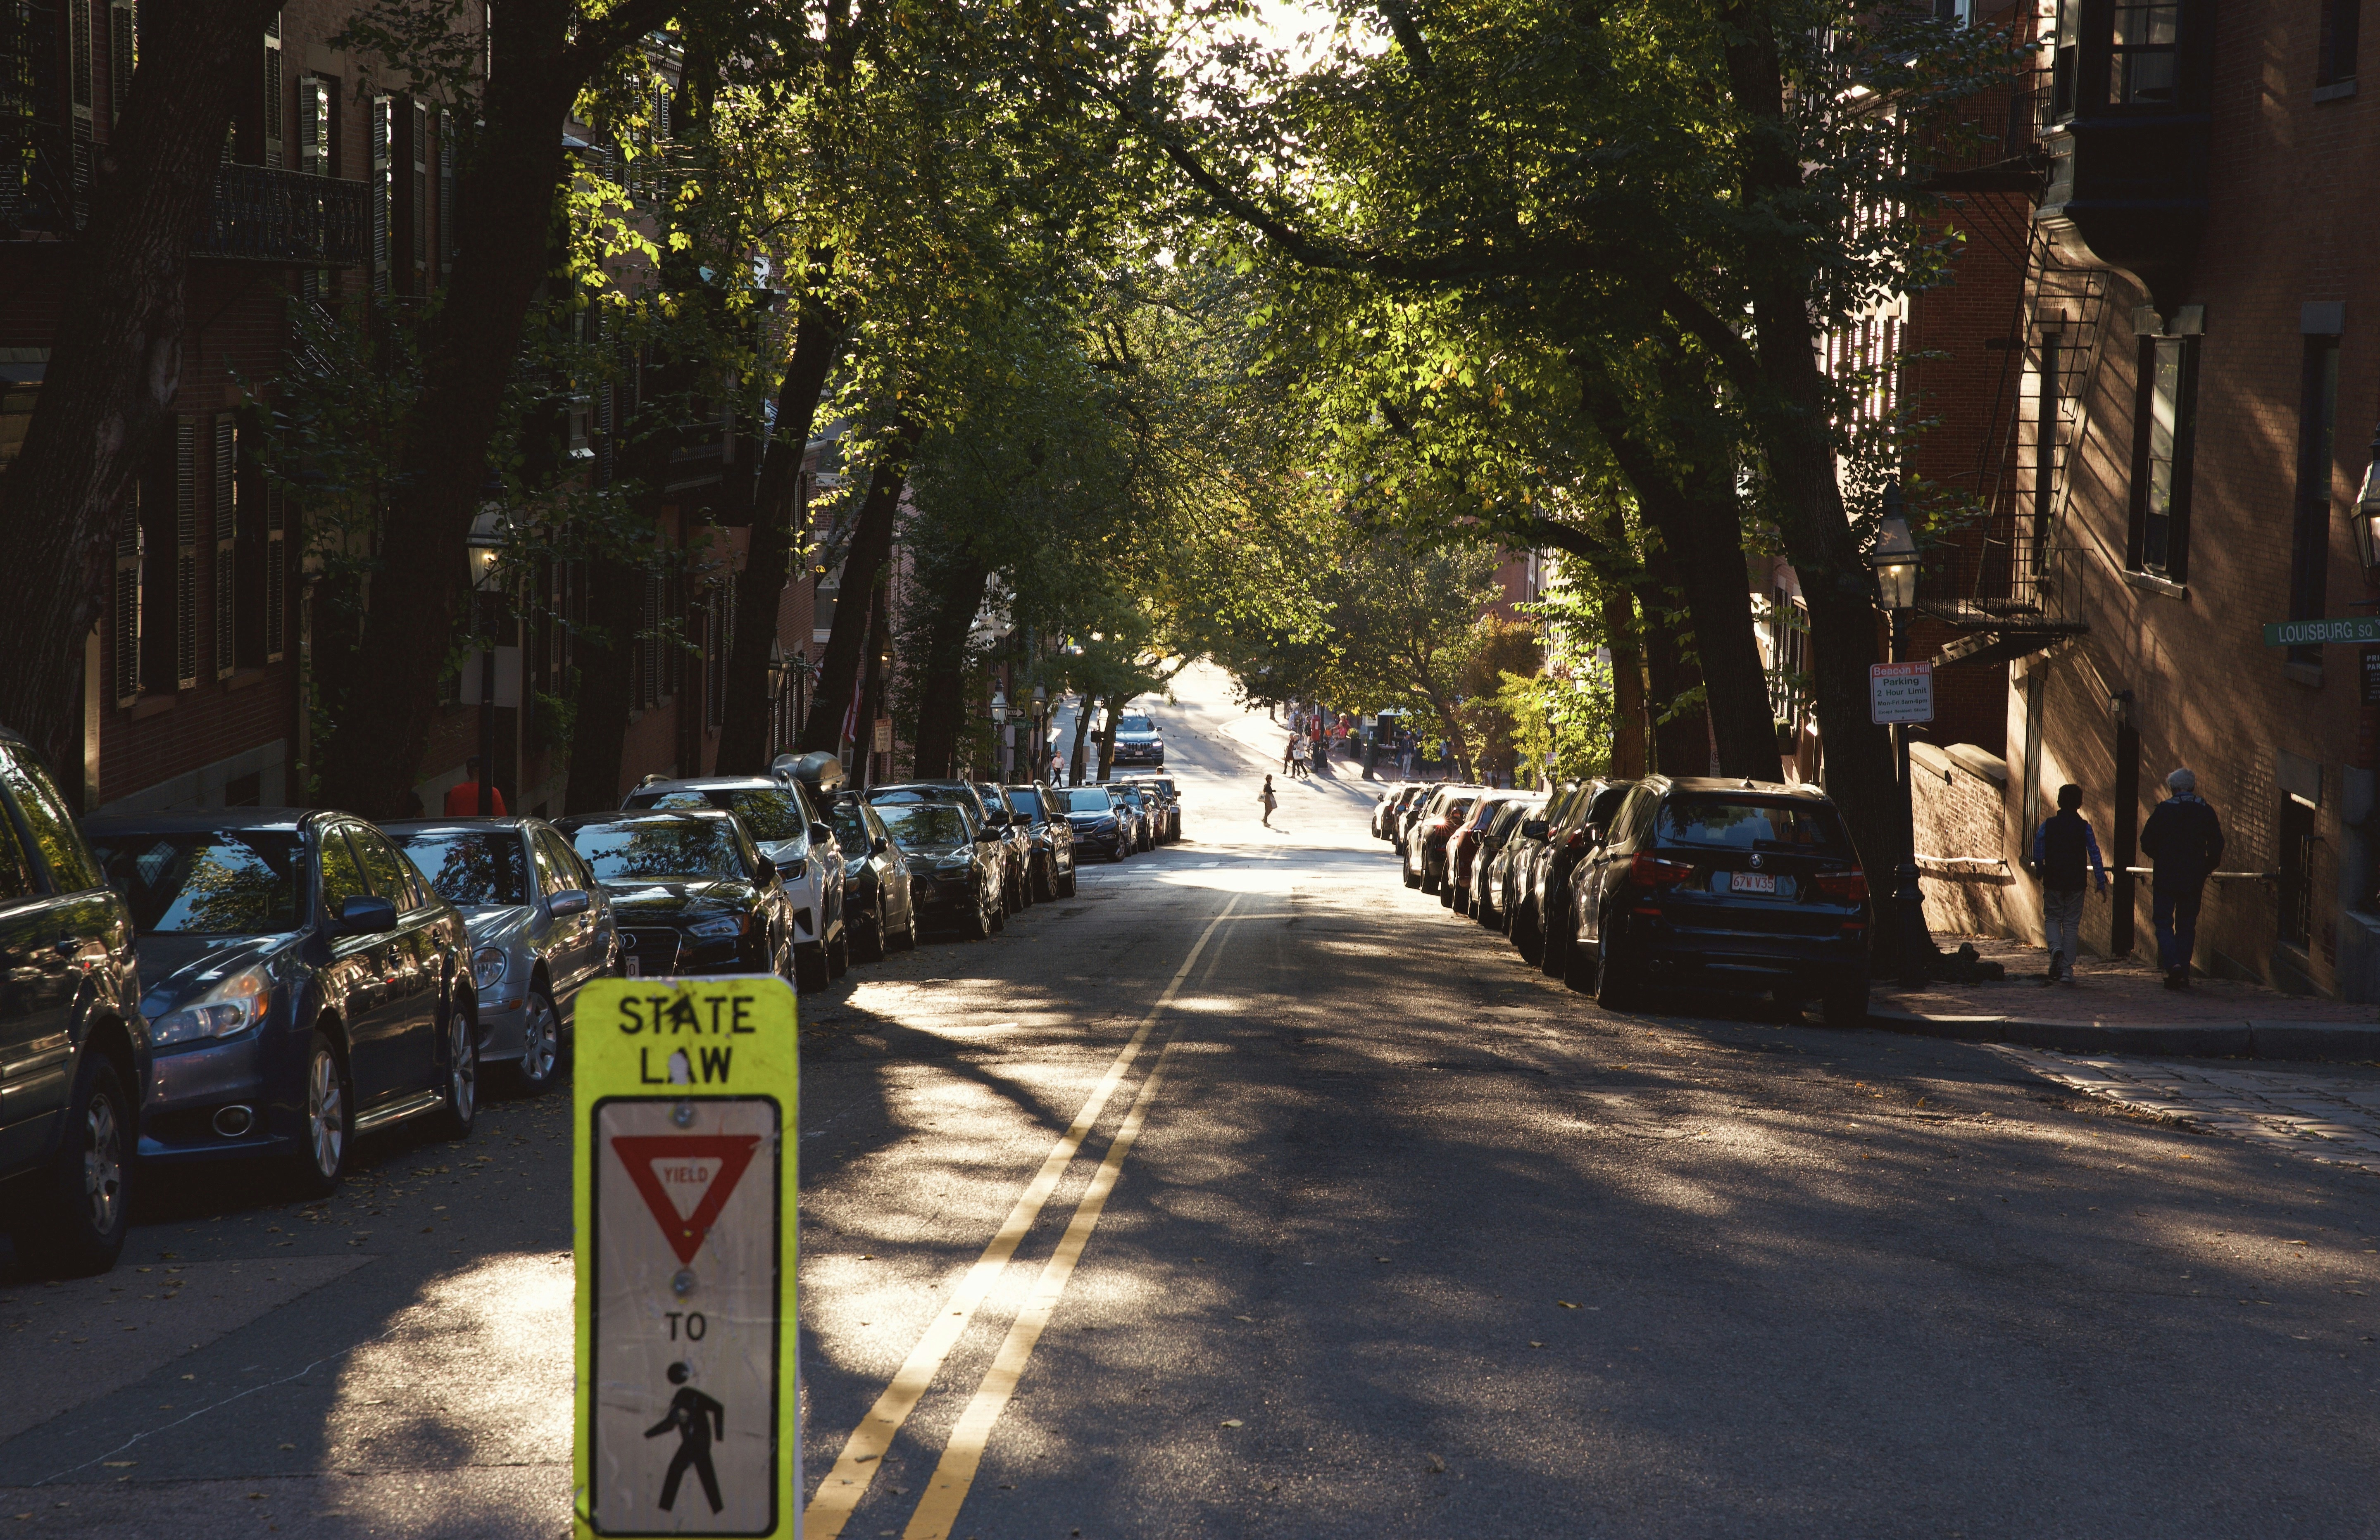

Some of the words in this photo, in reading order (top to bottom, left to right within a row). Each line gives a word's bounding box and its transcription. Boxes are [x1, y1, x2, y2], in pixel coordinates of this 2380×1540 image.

[2279, 622, 2353, 642] LOUISBURG
[2359, 624, 2372, 637] SQ
[1874, 667, 1911, 675] Beacon
[1915, 664, 1930, 673] Hill
[1883, 677, 1919, 686] Parking
[1734, 876, 1752, 888] 67W
[1755, 877, 1773, 889] V35
[619, 995, 755, 1034] STATE
[664, 1167, 708, 1184] YIELD
[664, 1312, 707, 1341] TO
